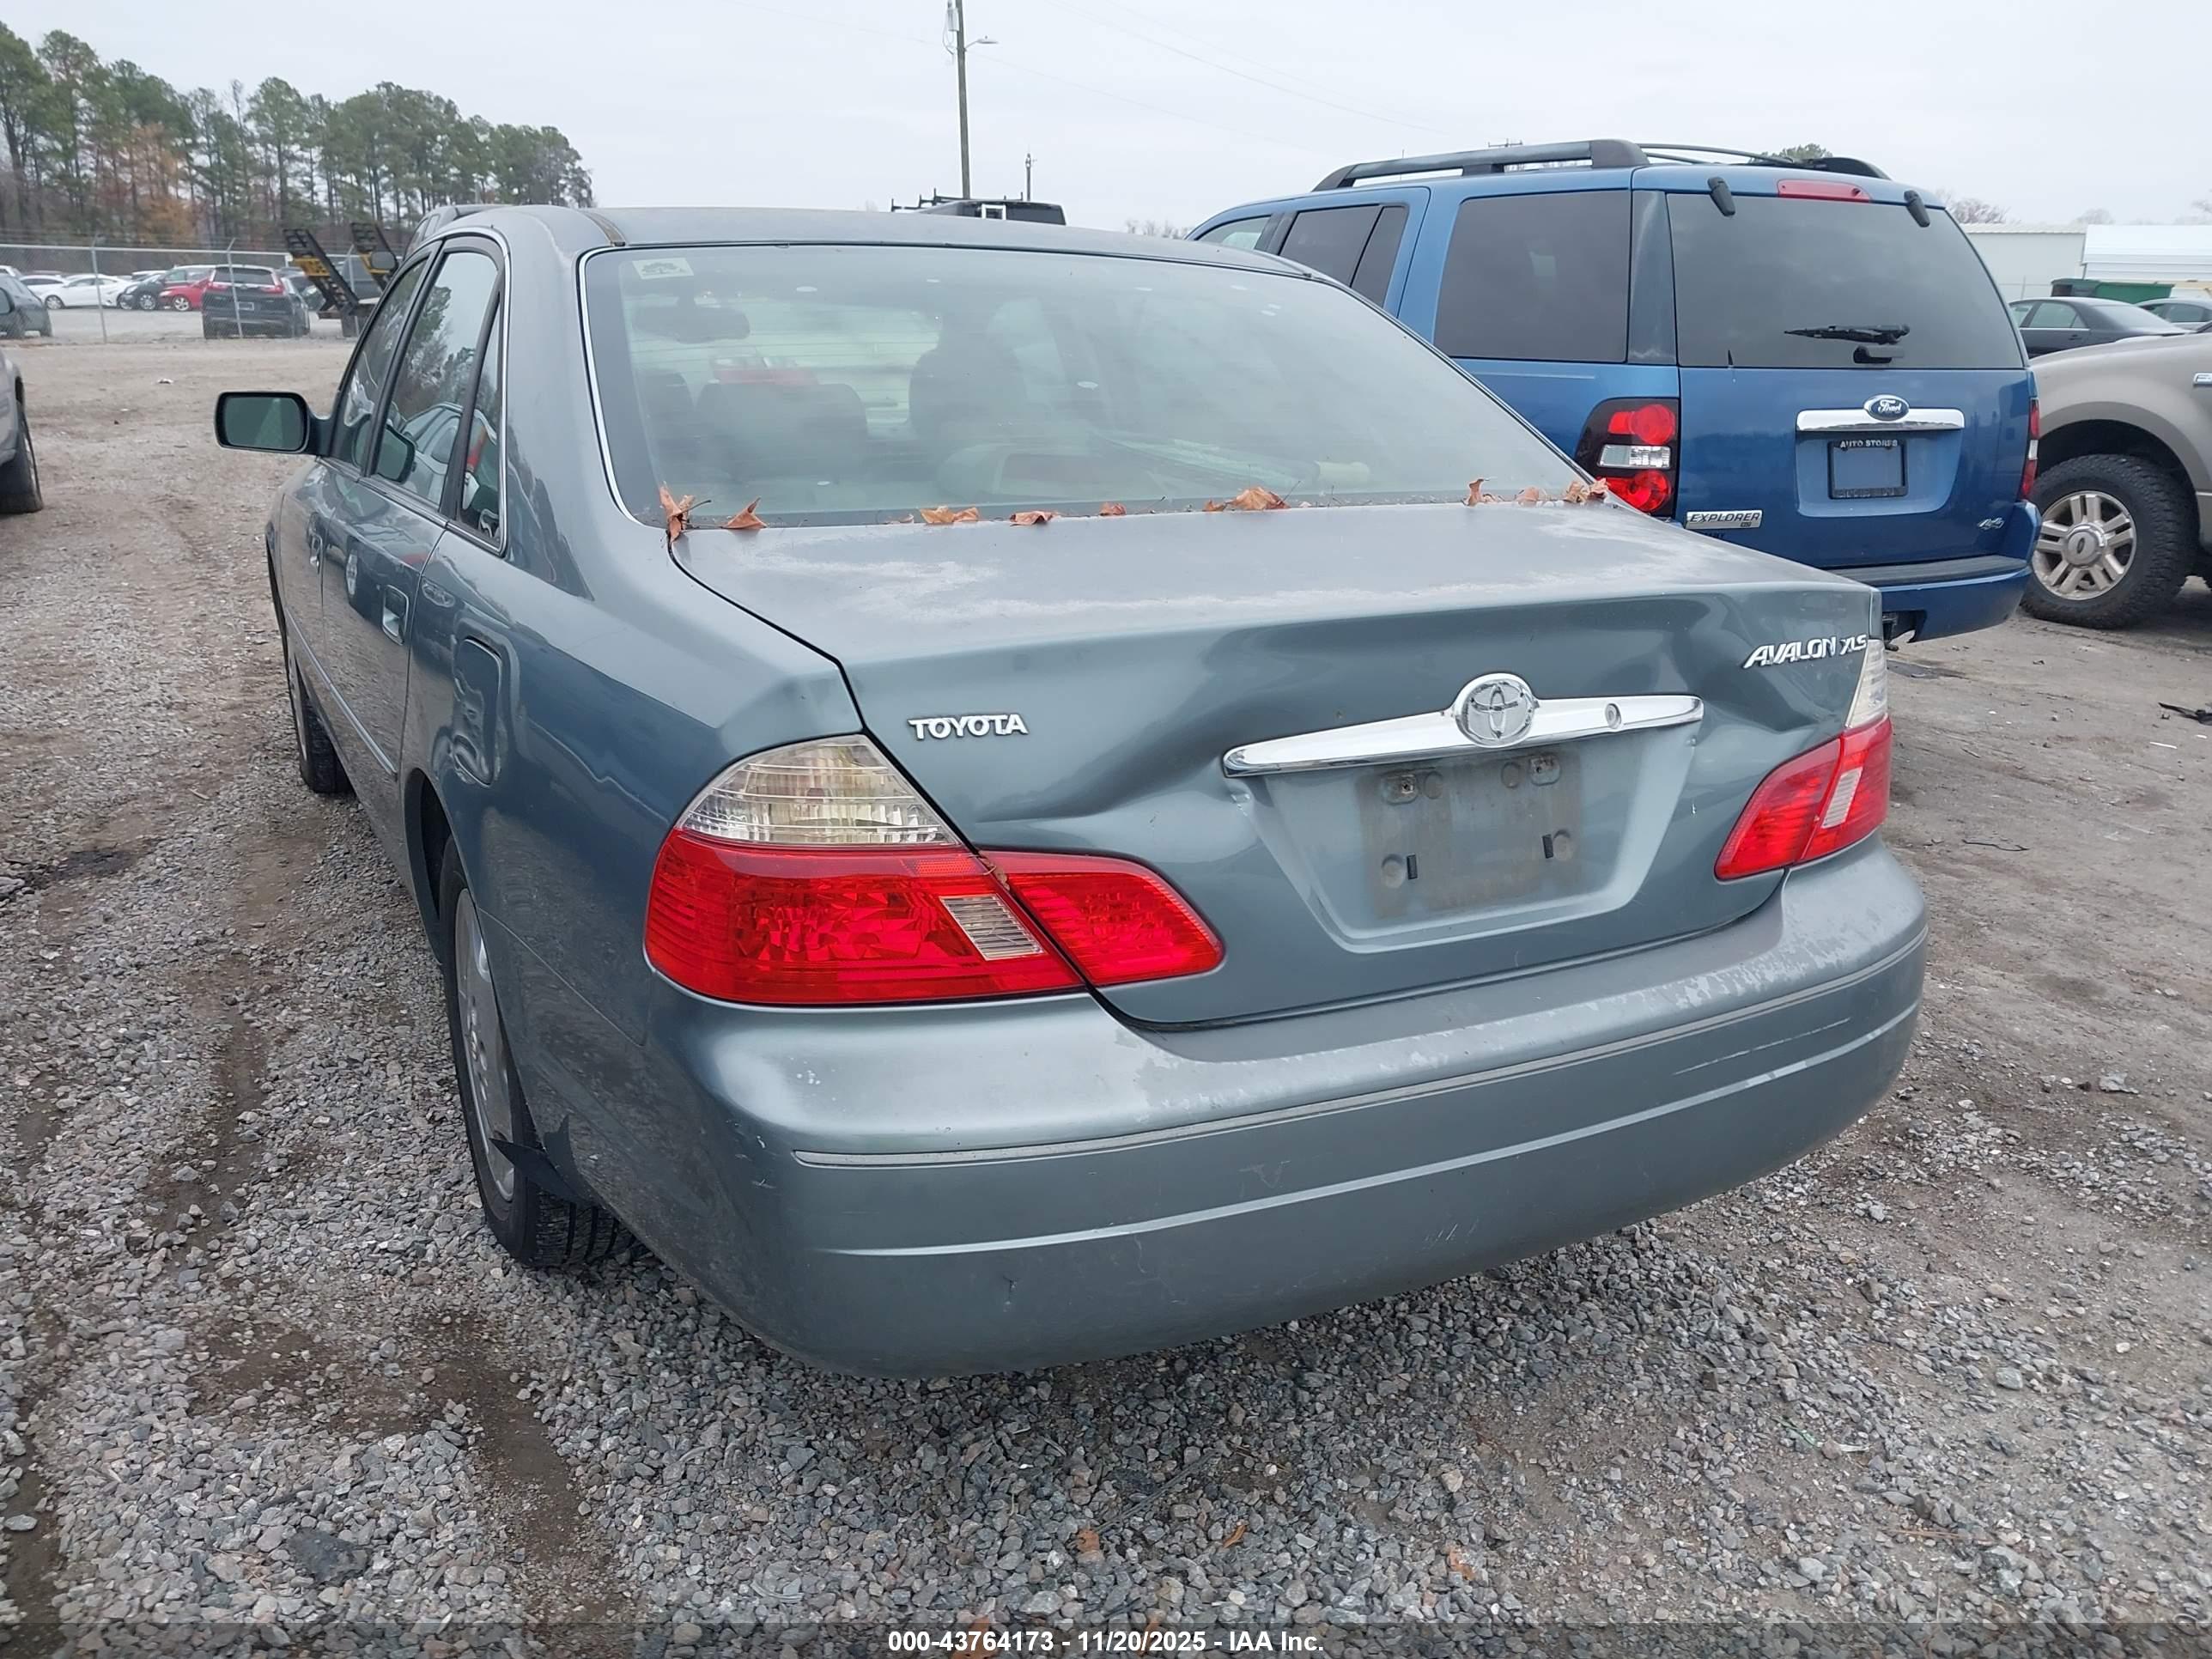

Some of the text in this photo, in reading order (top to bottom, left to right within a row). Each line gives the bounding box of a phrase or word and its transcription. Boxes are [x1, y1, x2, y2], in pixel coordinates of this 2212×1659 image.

[1877, 399, 1903, 415] Ford
[1839, 440, 1863, 448] AUTO
[1690, 513, 1761, 523] EXPLORER
[1742, 634, 1868, 670] AVALON XLS
[907, 713, 1030, 741] TOYOTA
